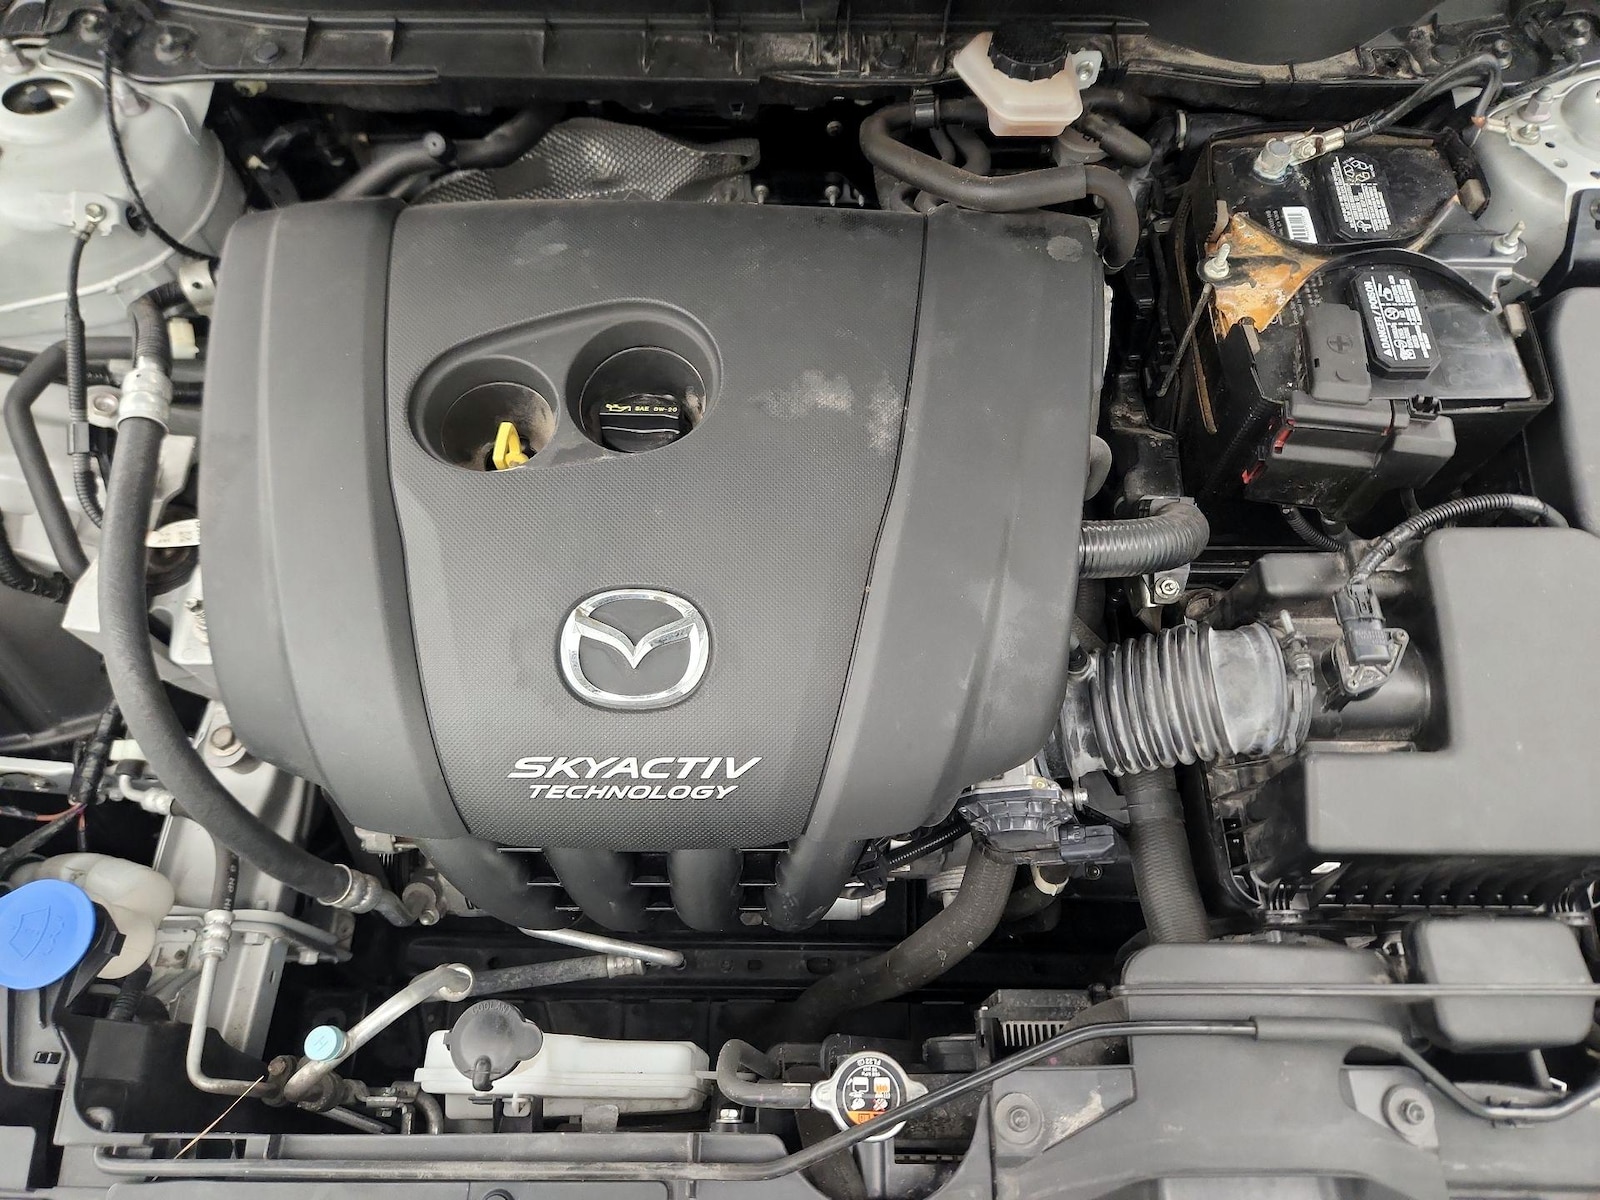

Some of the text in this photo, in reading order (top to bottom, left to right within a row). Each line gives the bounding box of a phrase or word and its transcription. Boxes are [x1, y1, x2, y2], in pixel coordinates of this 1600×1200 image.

[507, 756, 763, 779] SKYACTIV
[529, 784, 738, 800] TECHNOLOGY
[472, 1001, 512, 1016] COOLANT
